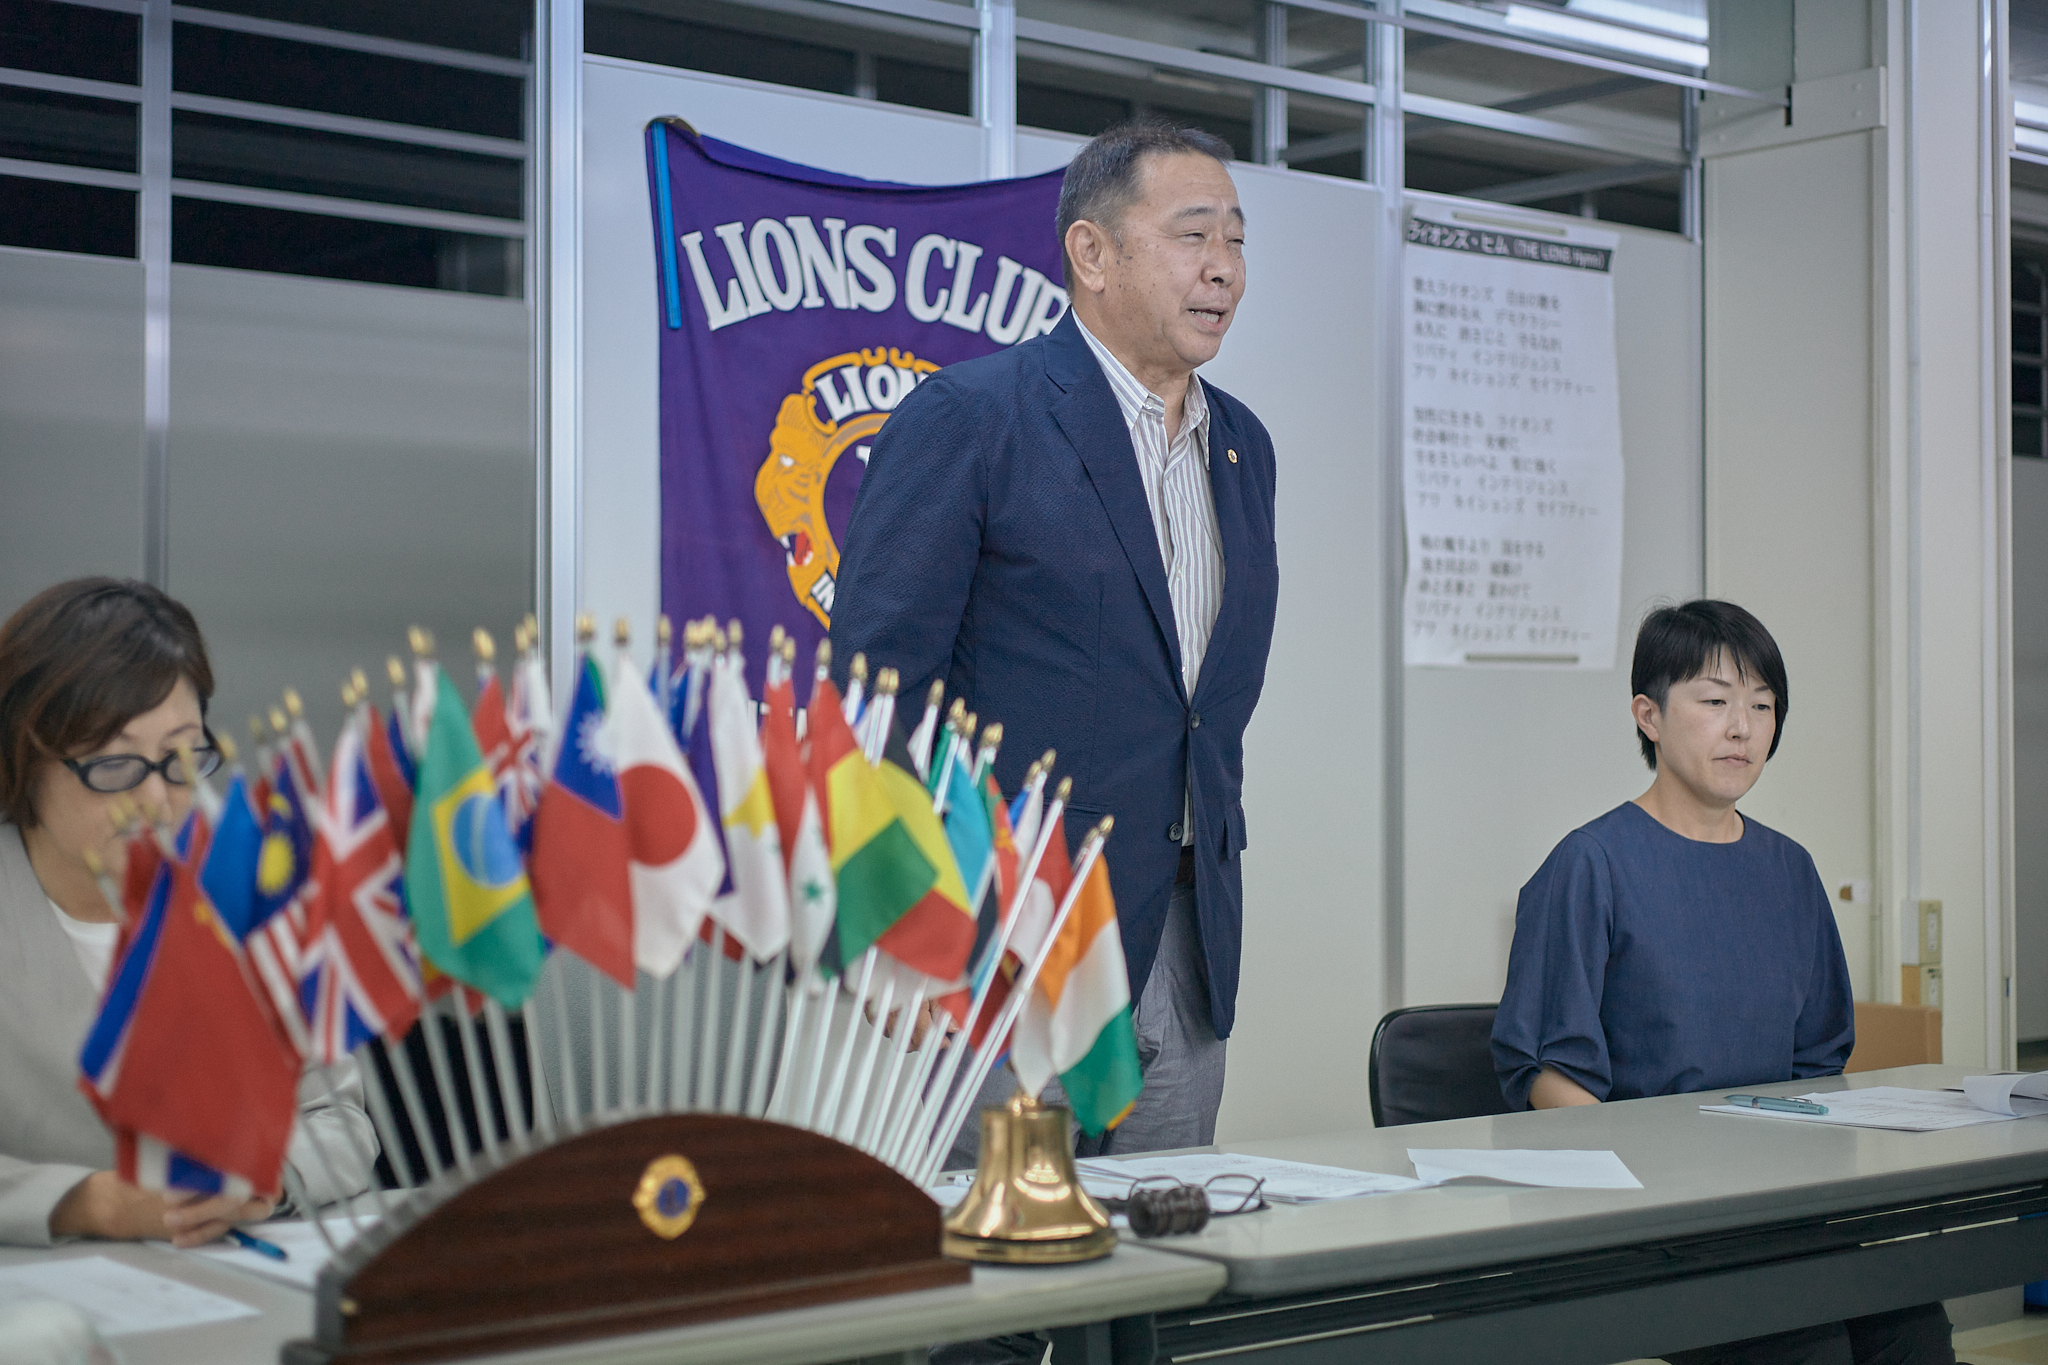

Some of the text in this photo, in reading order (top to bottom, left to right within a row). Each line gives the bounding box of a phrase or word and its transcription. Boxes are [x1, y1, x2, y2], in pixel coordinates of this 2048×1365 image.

[680, 216, 897, 332] LIONS
[1407, 220, 1510, 256] ライオンズ・ヒム
